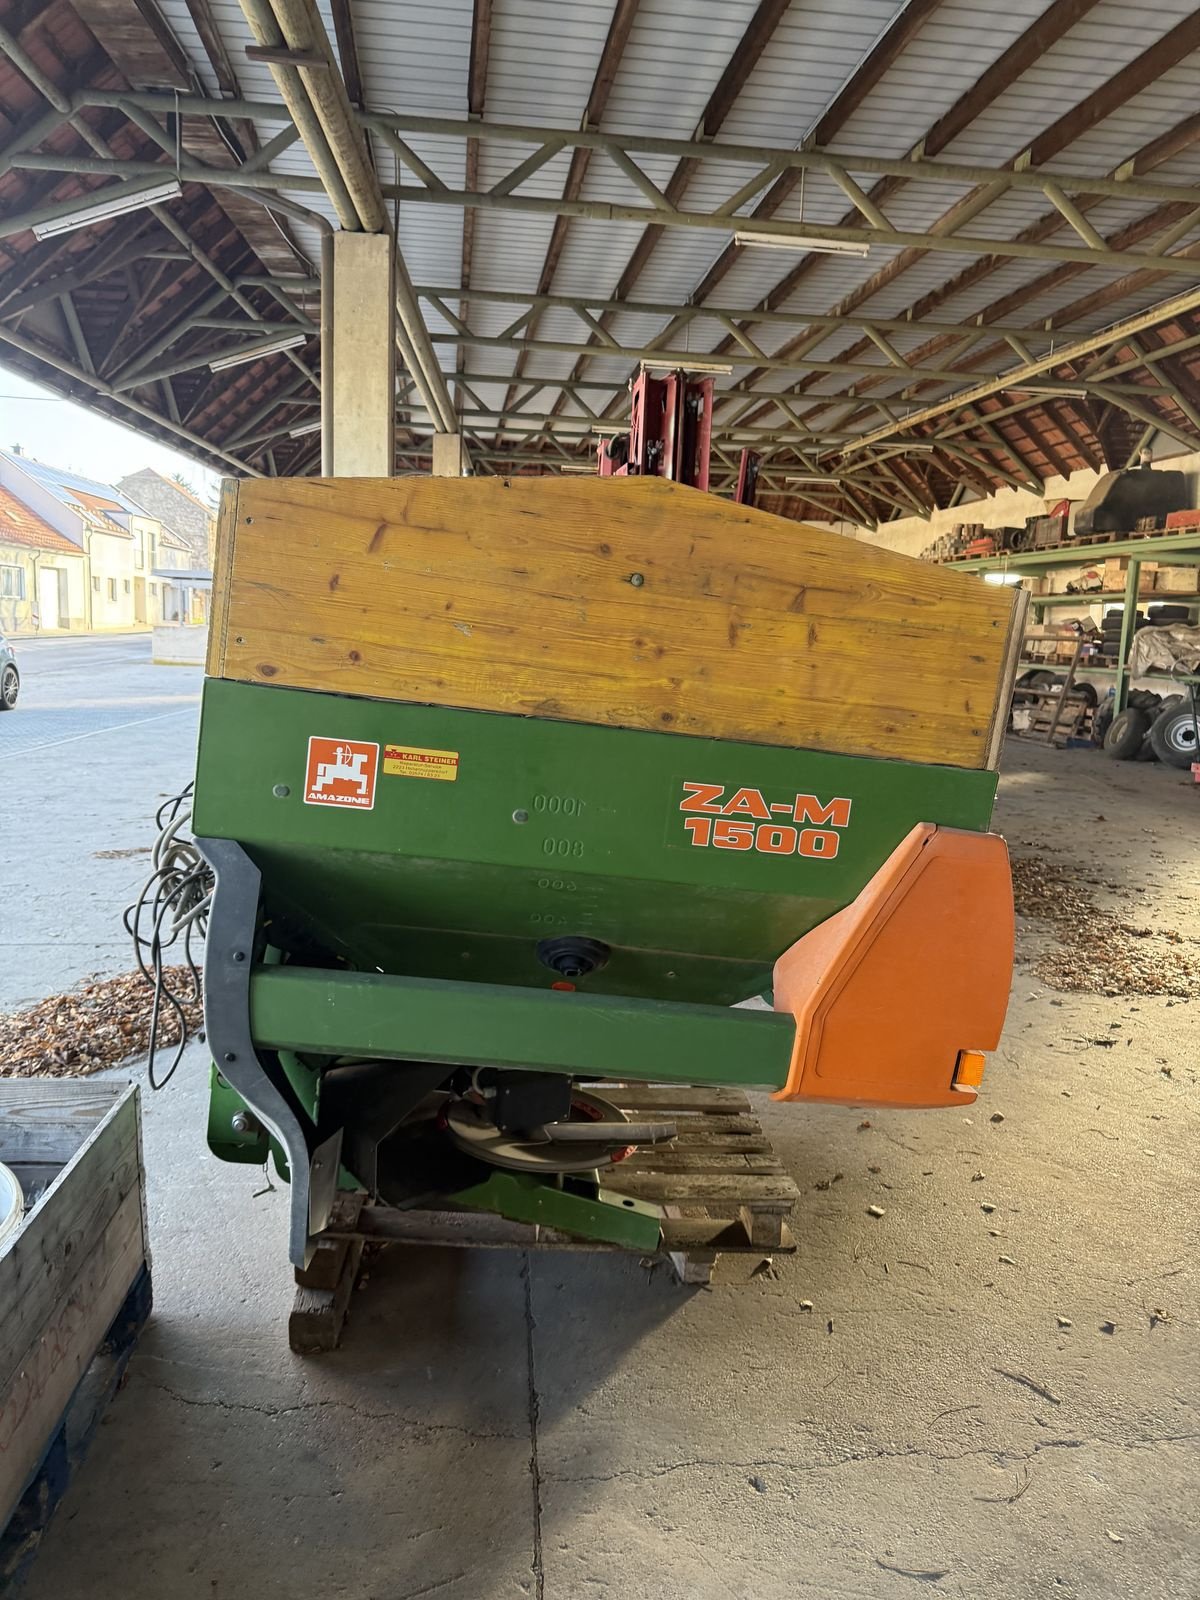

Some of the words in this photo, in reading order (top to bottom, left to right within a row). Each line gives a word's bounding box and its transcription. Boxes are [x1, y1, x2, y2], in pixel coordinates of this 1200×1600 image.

[402, 753, 423, 762] KARL
[424, 756, 457, 765] STEINER
[307, 792, 370, 805] AMAZONE
[679, 781, 852, 828] ZA-M
[684, 816, 840, 860] 1500
